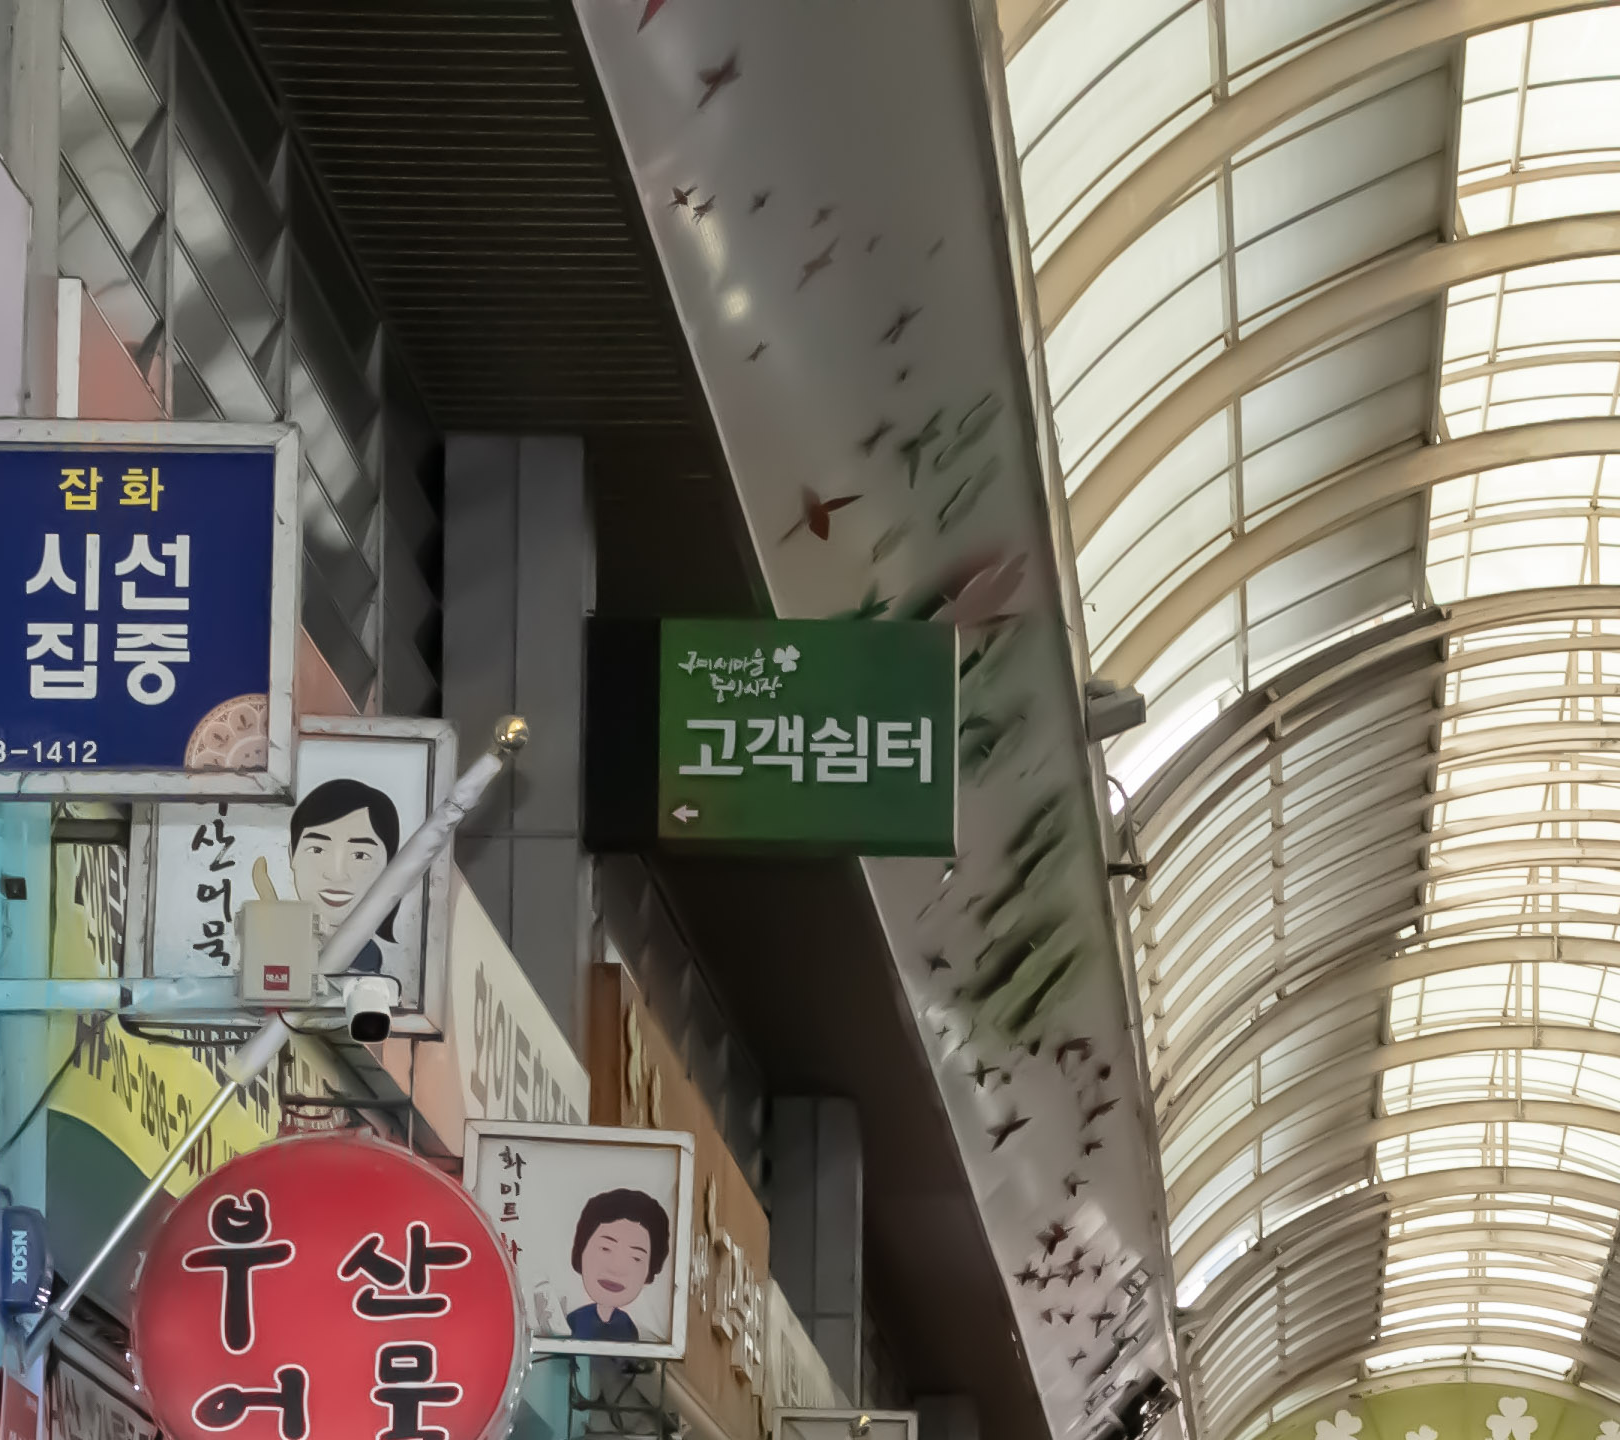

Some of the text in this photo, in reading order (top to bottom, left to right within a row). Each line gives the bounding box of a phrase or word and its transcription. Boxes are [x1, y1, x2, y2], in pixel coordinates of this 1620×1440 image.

[58, 467, 164, 511] 잡화
[25, 533, 190, 611] 시선
[26, 623, 190, 705] 집중
[679, 715, 932, 783] 고객쉼터
[189, 801, 236, 967] 산어묵
[12, 1230, 28, 1285] NSOK
[182, 1189, 472, 1355] 우산
